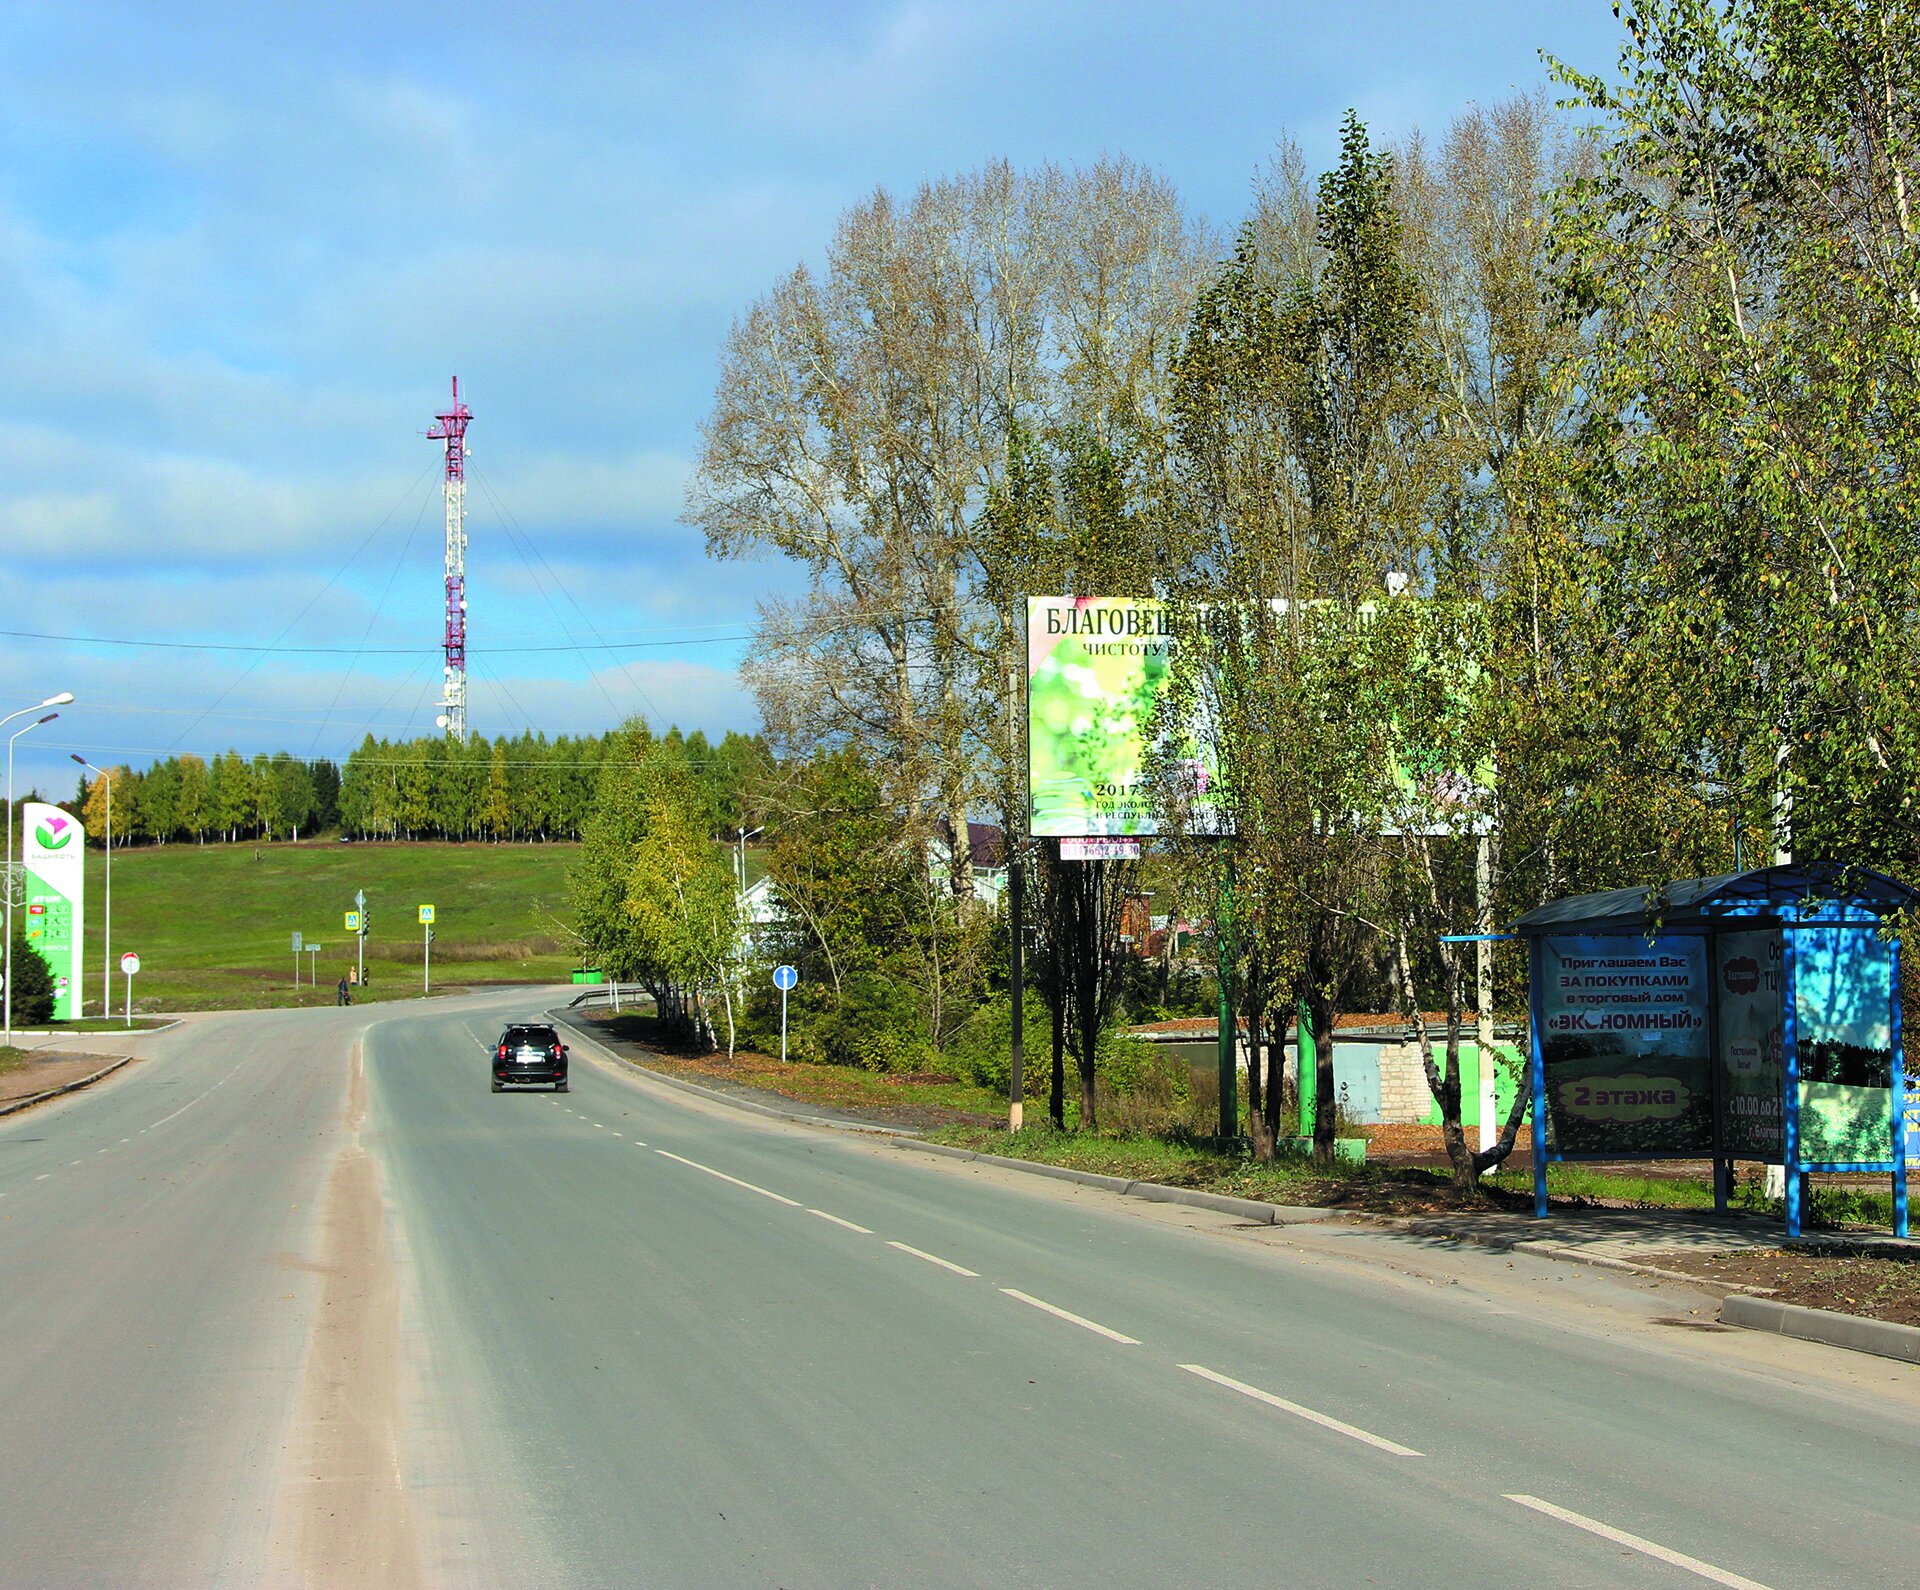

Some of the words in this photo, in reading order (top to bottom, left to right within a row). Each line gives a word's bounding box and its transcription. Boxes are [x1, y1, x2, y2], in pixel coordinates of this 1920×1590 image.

[1083, 643, 1163, 656] ЧИСТОТУ
[1096, 801, 1116, 809] ГОД
[1561, 957, 1656, 970] Приглашаем
[1659, 956, 1686, 968] Вас
[1560, 976, 1581, 987] ЗА
[1585, 975, 1689, 987] ПОКУПКАМИ
[1579, 991, 1650, 1005] торговый
[1654, 994, 1684, 1003] дом
[1574, 1087, 1590, 1106] 2
[1596, 1089, 1676, 1106] этажа
